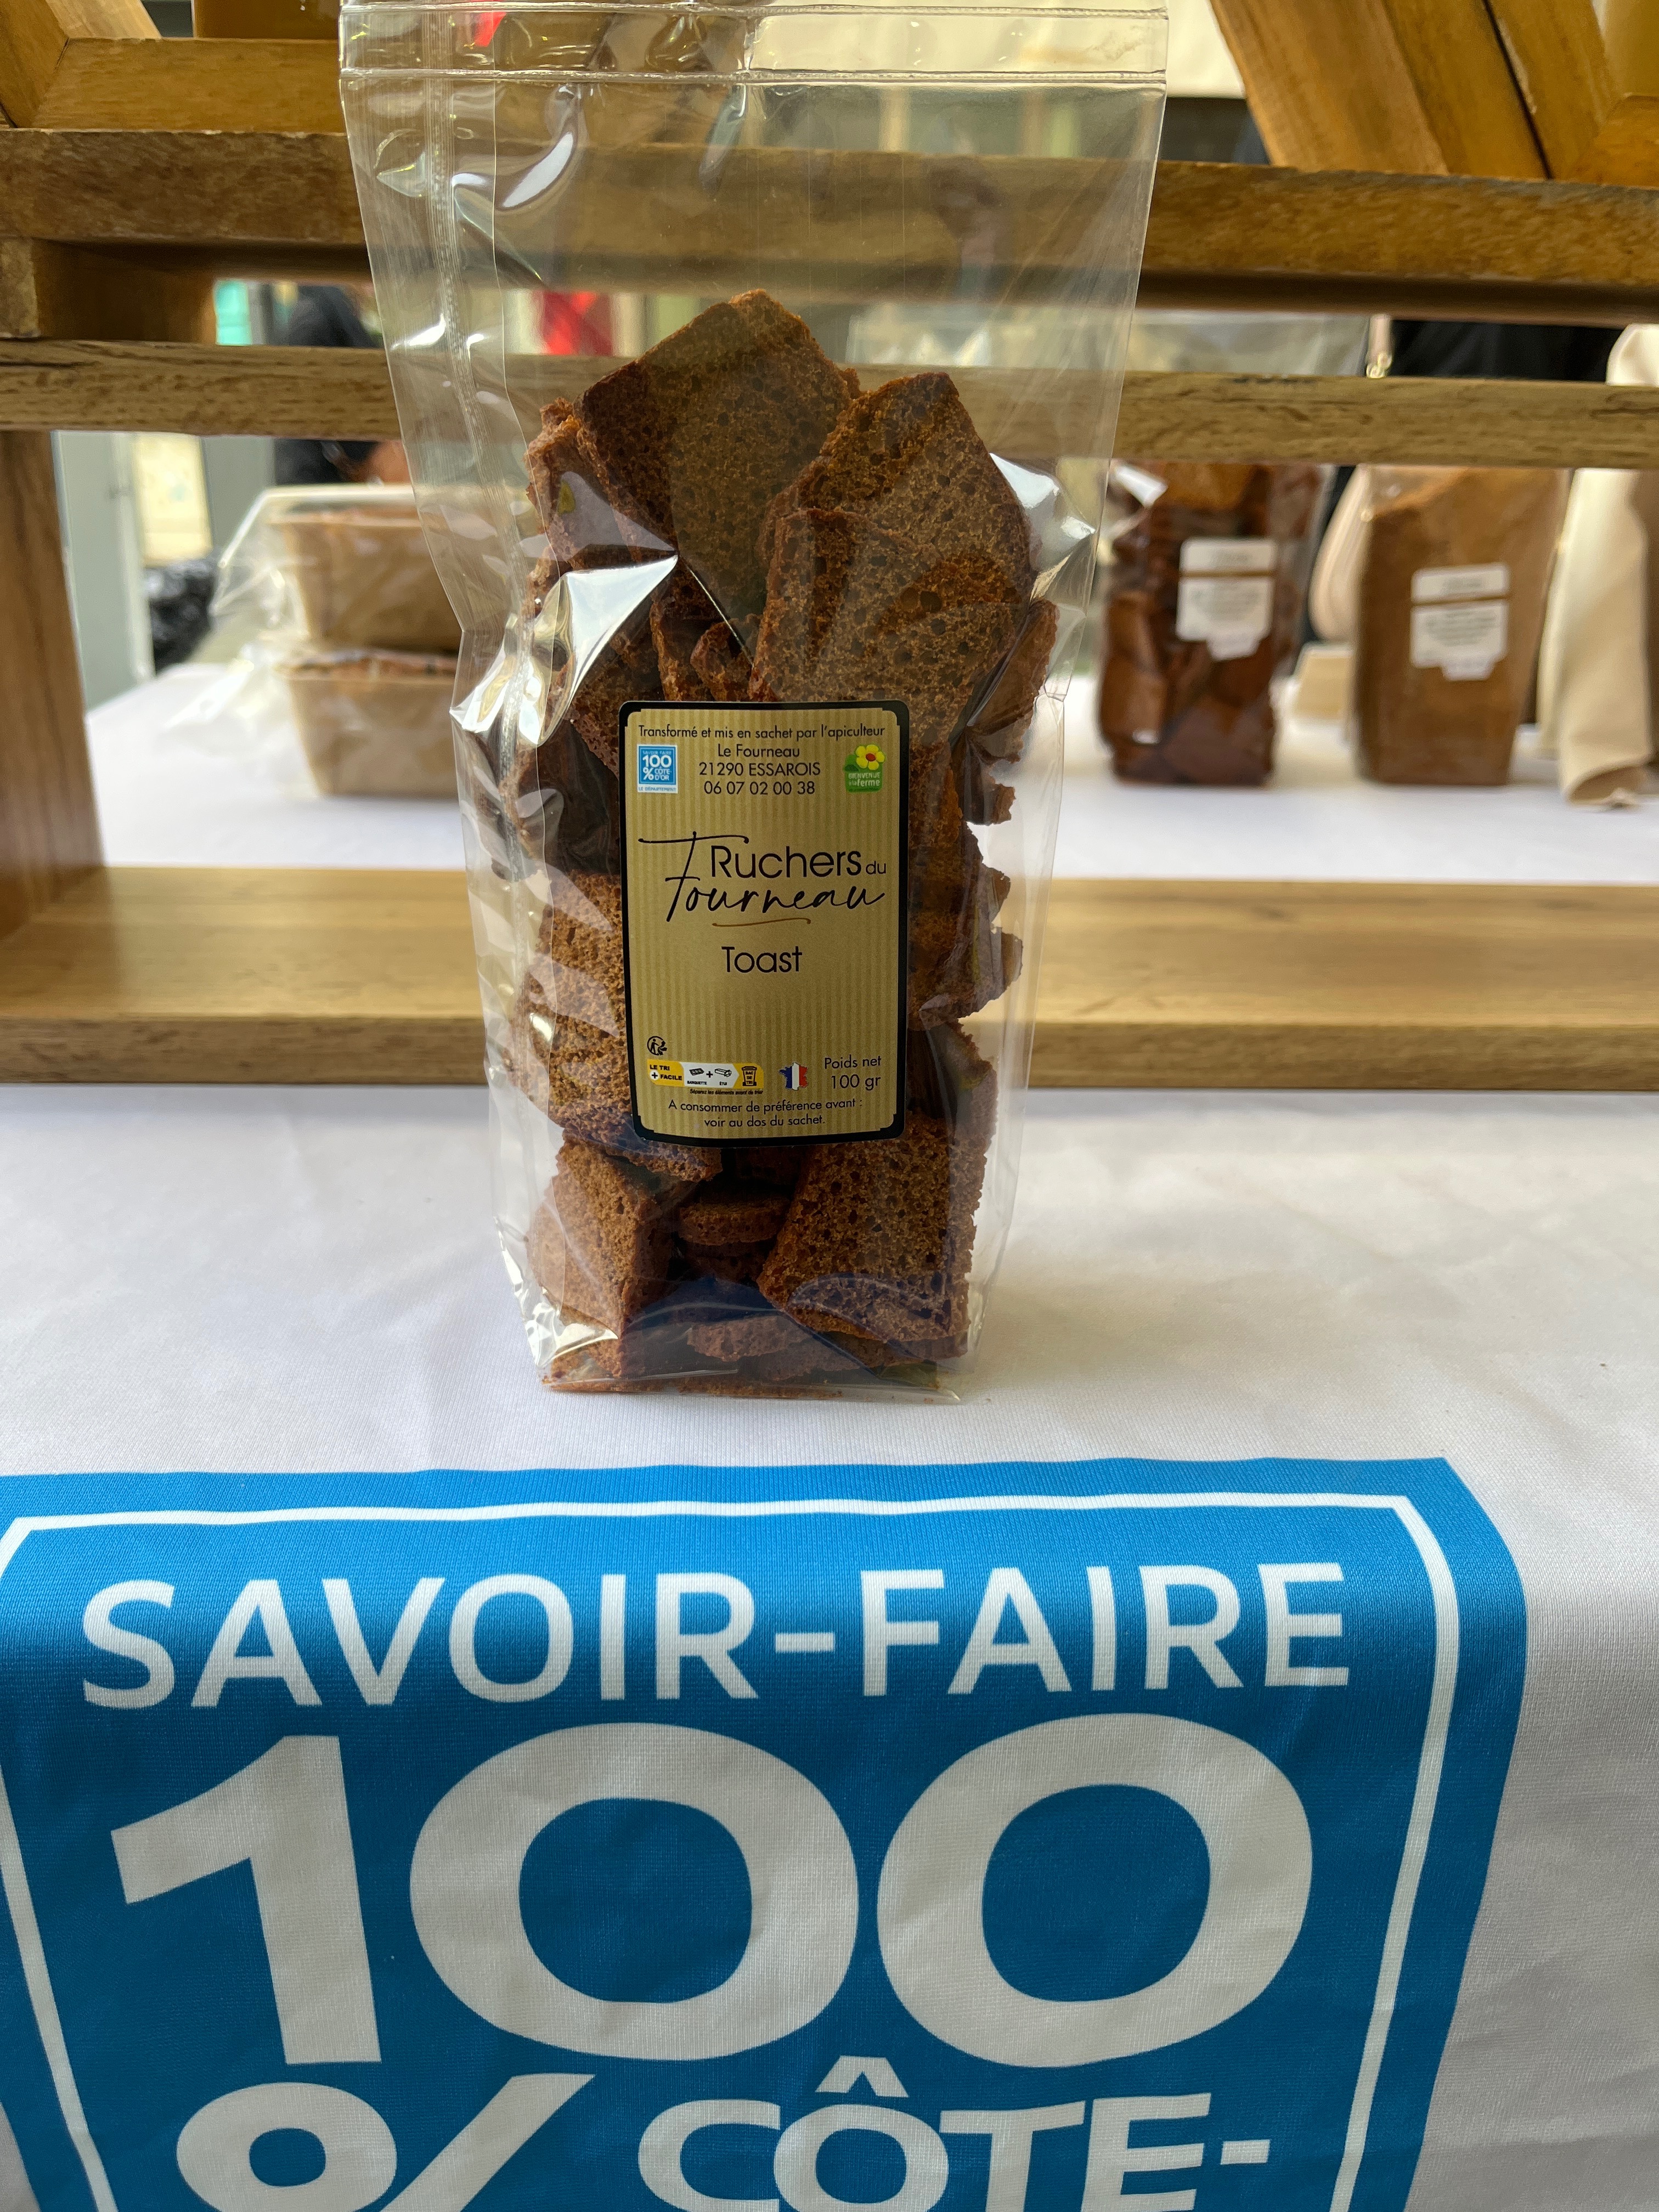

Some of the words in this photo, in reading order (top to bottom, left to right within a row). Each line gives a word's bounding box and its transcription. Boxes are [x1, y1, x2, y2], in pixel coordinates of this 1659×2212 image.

[638, 724, 698, 738] Transformé
[701, 727, 711, 738] et
[715, 727, 734, 738] mis
[737, 729, 752, 738] en
[754, 725, 792, 739] sachet
[796, 728, 817, 742] par
[821, 723, 885, 741] l'apiculteur
[718, 744, 732, 757] Le
[736, 744, 800, 758] Fourneau
[642, 754, 672, 768] 100
[698, 763, 744, 776] 21290
[748, 761, 821, 776] ESSAROIS
[642, 767, 654, 780] %
[704, 781, 722, 795] 06
[726, 781, 745, 795] 07
[749, 781, 768, 795] 02
[773, 781, 793, 795] 00
[797, 781, 816, 795] 38
[857, 778, 881, 787] ferme
[710, 845, 862, 878] Ruchers
[865, 860, 887, 875] du
[638, 831, 885, 922] Fourneau
[721, 945, 803, 974] Toast
[824, 1054, 859, 1070] Poids
[862, 1056, 882, 1068] net
[830, 1074, 861, 1090] 100
[865, 1076, 882, 1092] gr
[668, 1099, 678, 1110] A
[680, 1102, 742, 1113] consommer
[746, 1100, 760, 1112] de
[763, 1099, 823, 1115] préférence
[825, 1098, 856, 1109] avant
[704, 1118, 726, 1127] voir
[730, 1119, 743, 1127] au
[747, 1116, 767, 1127] dos
[770, 1114, 785, 1126] du
[787, 1113, 825, 1126] sachet.
[81, 1561, 1350, 1709] SAVOIR-FAIRE
[110, 1711, 1313, 2069] 100
[636, 2055, 1273, 2212] CÔTE-
